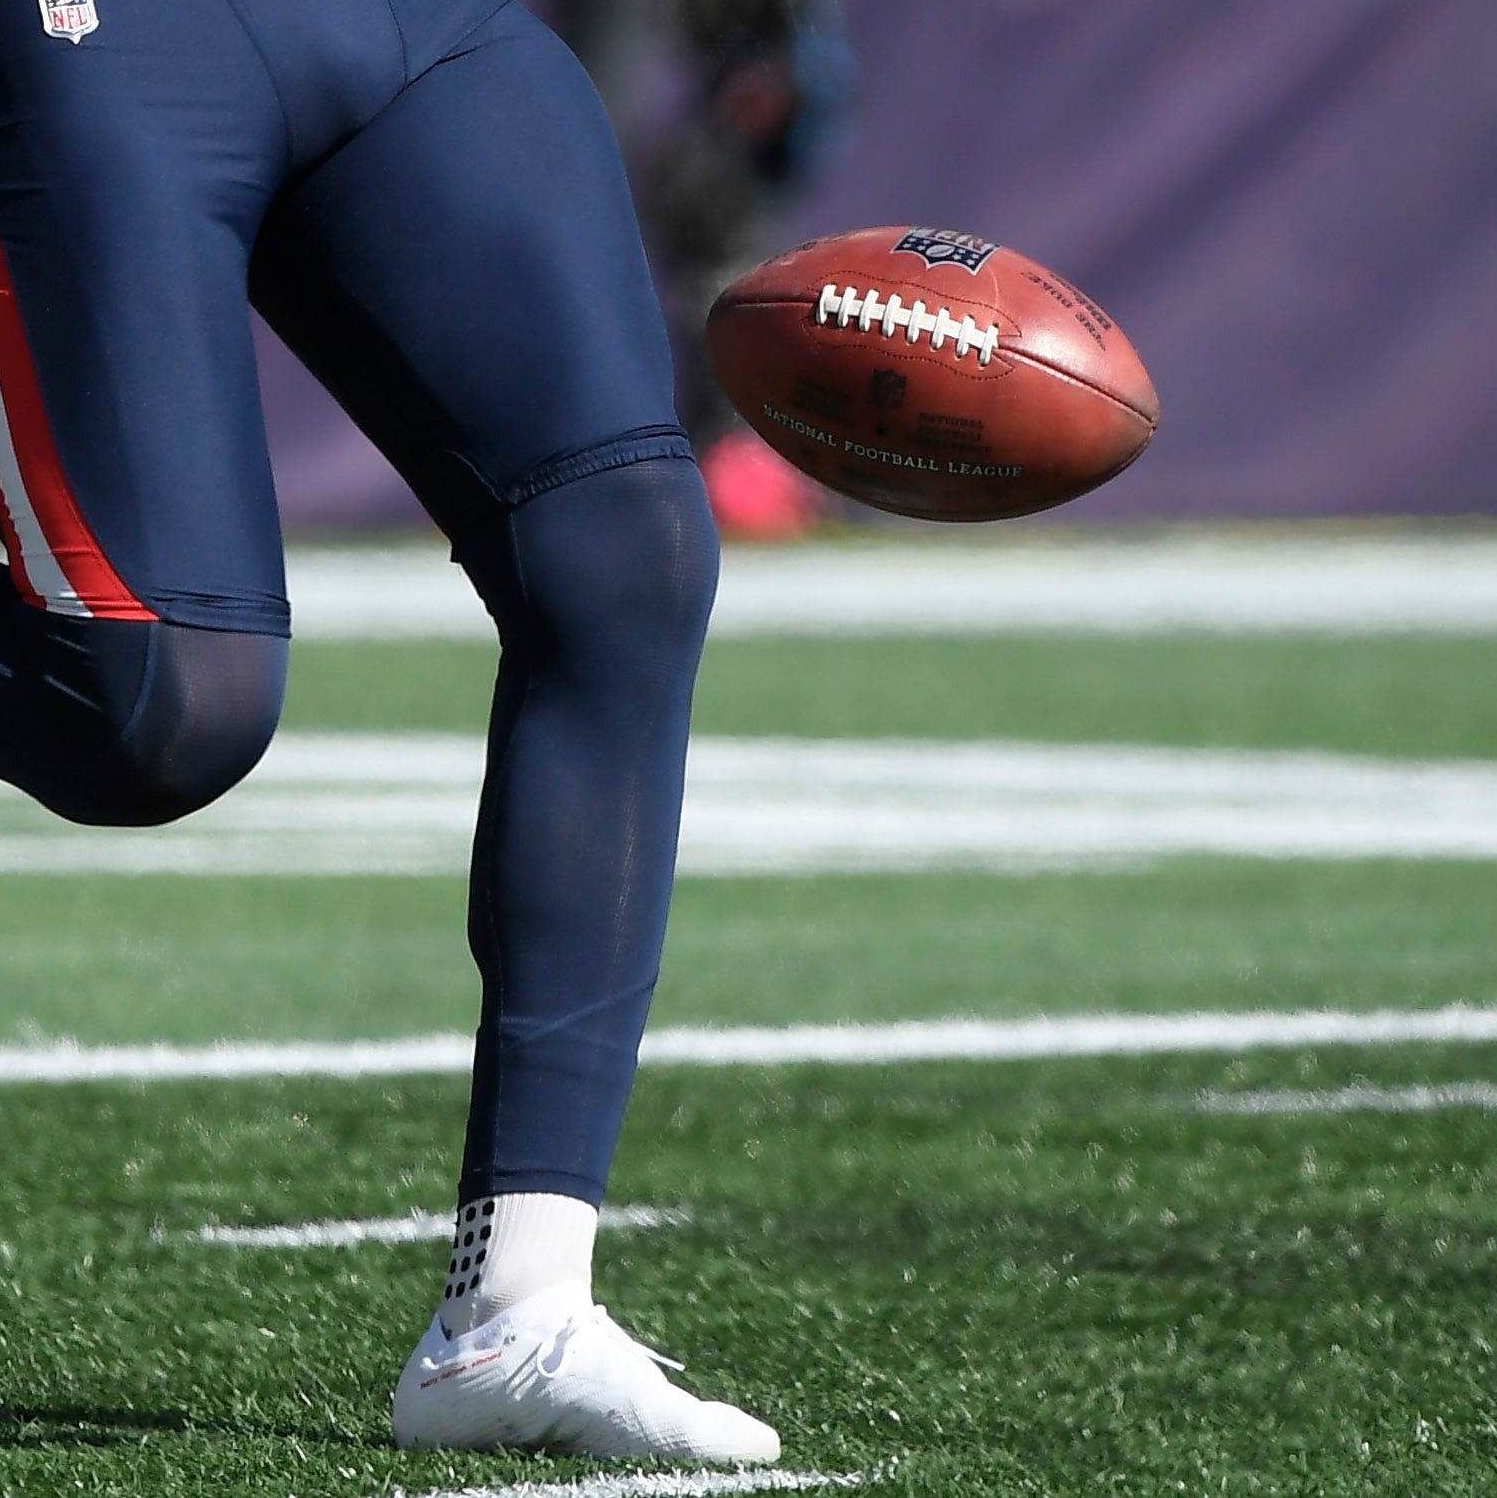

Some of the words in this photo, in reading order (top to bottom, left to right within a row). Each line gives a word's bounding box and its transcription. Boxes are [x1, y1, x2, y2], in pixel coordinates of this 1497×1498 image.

[50, 6, 88, 30] NFL
[761, 402, 838, 449] NATIONAL
[844, 440, 939, 472] FOOTBALL
[948, 461, 1024, 479] LEAGUE
